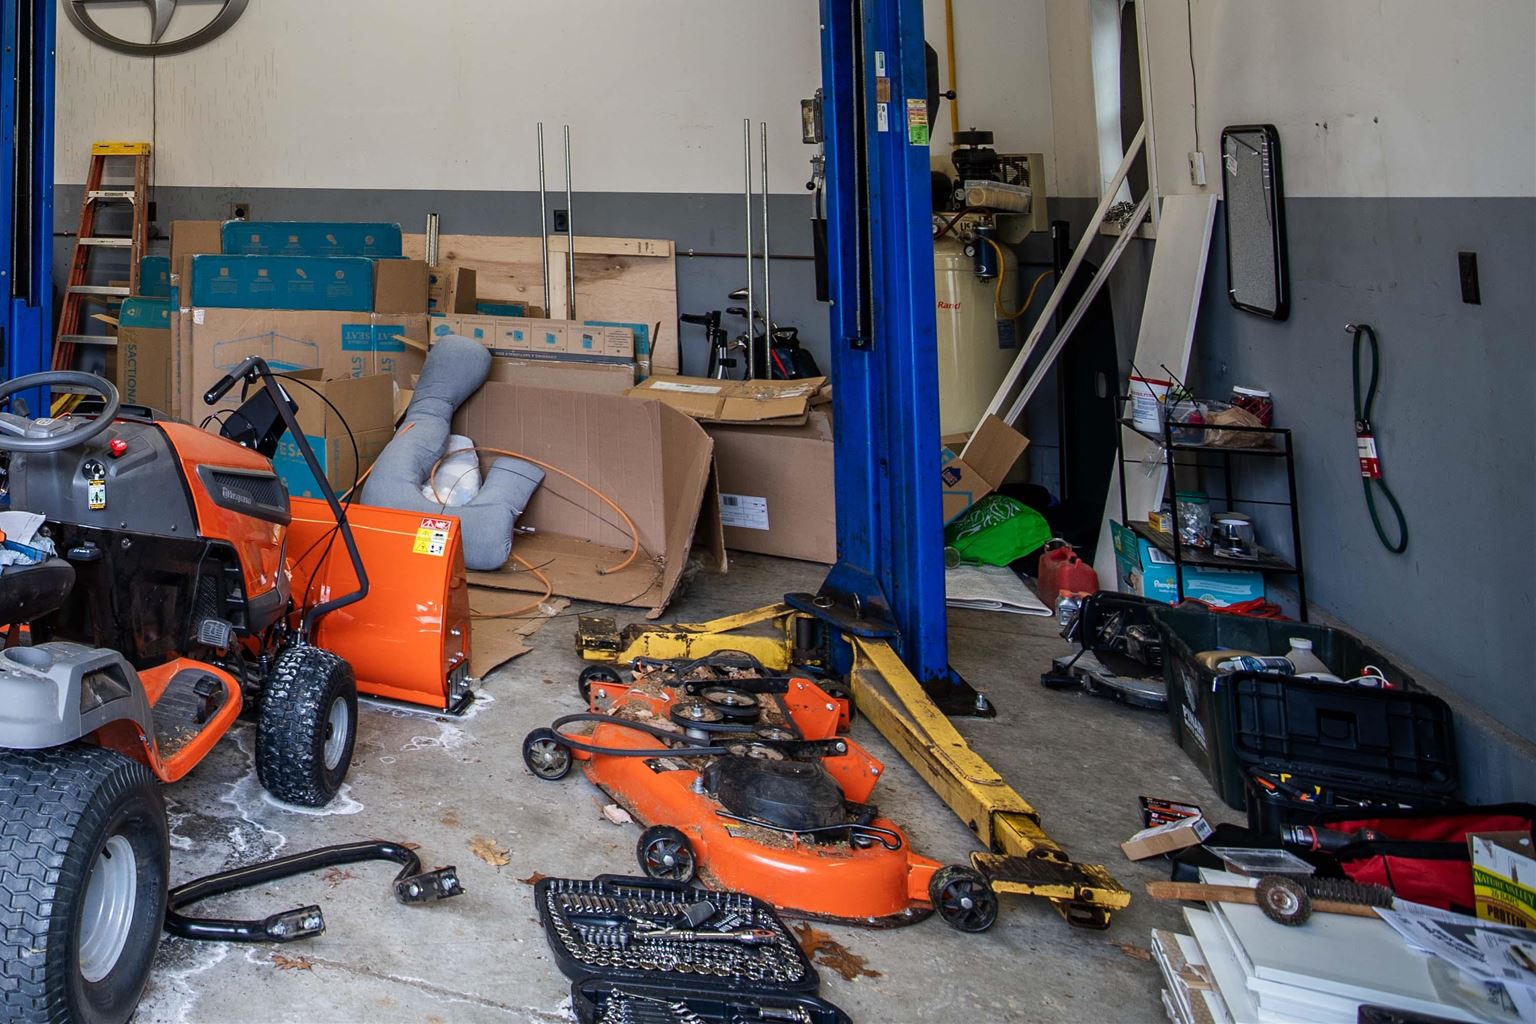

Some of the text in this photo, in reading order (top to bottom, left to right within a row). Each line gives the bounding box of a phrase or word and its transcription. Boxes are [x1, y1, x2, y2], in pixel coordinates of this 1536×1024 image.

[128, 344, 137, 404] SACTIONA
[351, 357, 362, 378] ALS
[1505, 883, 1534, 907] VALLEY
